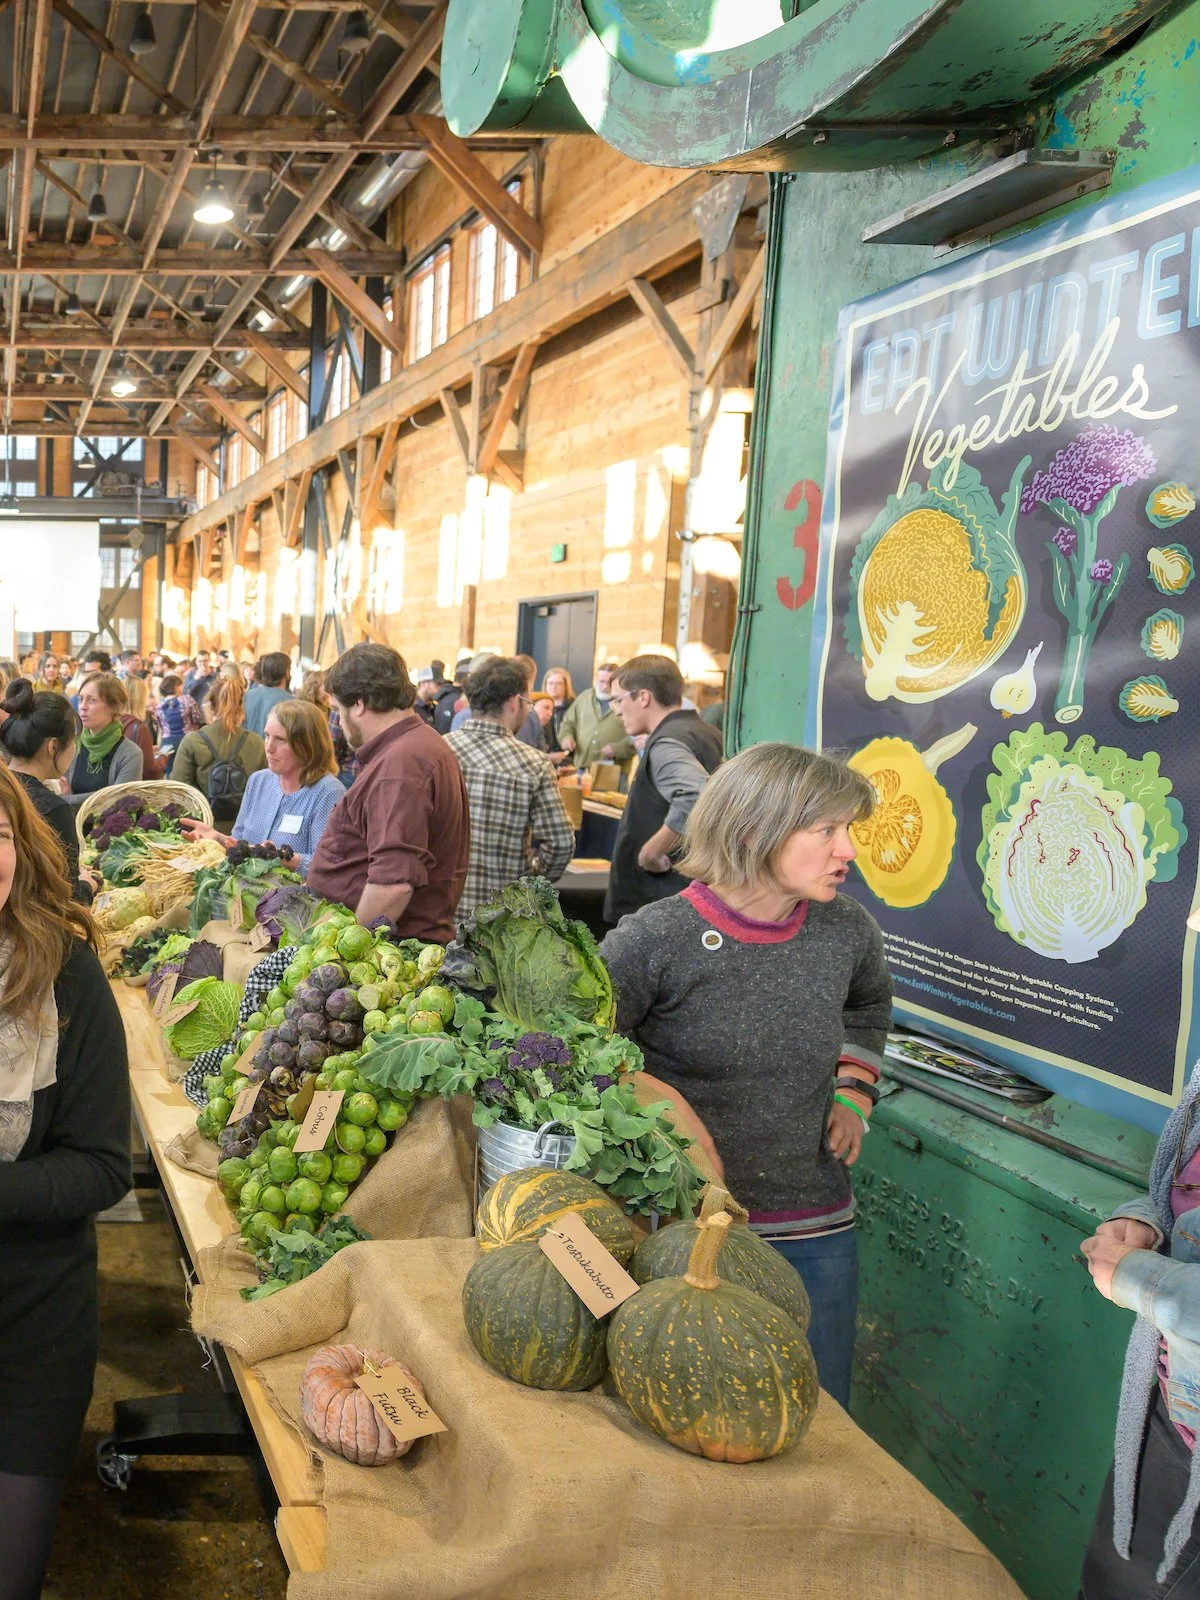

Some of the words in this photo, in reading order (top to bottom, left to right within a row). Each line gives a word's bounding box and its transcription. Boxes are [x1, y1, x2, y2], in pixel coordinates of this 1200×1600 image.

[860, 312, 956, 416] EAT
[895, 317, 1178, 499] Vegetables
[776, 479, 823, 611] 3
[890, 944, 912, 958] University
[940, 962, 961, 973] Program
[962, 970, 973, 978] and
[973, 973, 983, 981] the
[984, 977, 1009, 990] Culinary
[1010, 984, 1038, 999] Breeding
[1039, 992, 1068, 1007] Network
[1069, 1002, 1085, 1012] with
[1085, 1006, 1114, 1022] funding
[901, 960, 915, 970] Grant
[915, 964, 935, 976] Program
[935, 973, 967, 988] administered
[966, 984, 990, 996] through
[990, 990, 1014, 1003] Oregon
[1014, 998, 1052, 1016] Department
[1061, 1013, 1101, 1031] Agriculture.
[937, 949, 944, 957] by
[944, 951, 954, 960] the
[954, 955, 974, 965] Oregon
[974, 961, 990, 970] State
[989, 965, 1020, 980] University
[1021, 974, 1053, 989] Vegetable
[1054, 984, 1084, 999] Cropping
[1085, 993, 1114, 1007] Systems
[310, 1105, 328, 1136] Cobus
[879, 1176, 931, 1222] BLISS
[927, 1230, 939, 1251] &
[944, 1237, 998, 1289] TOOL
[372, 1392, 403, 1425] Futsu
[397, 1386, 429, 1420] Black
